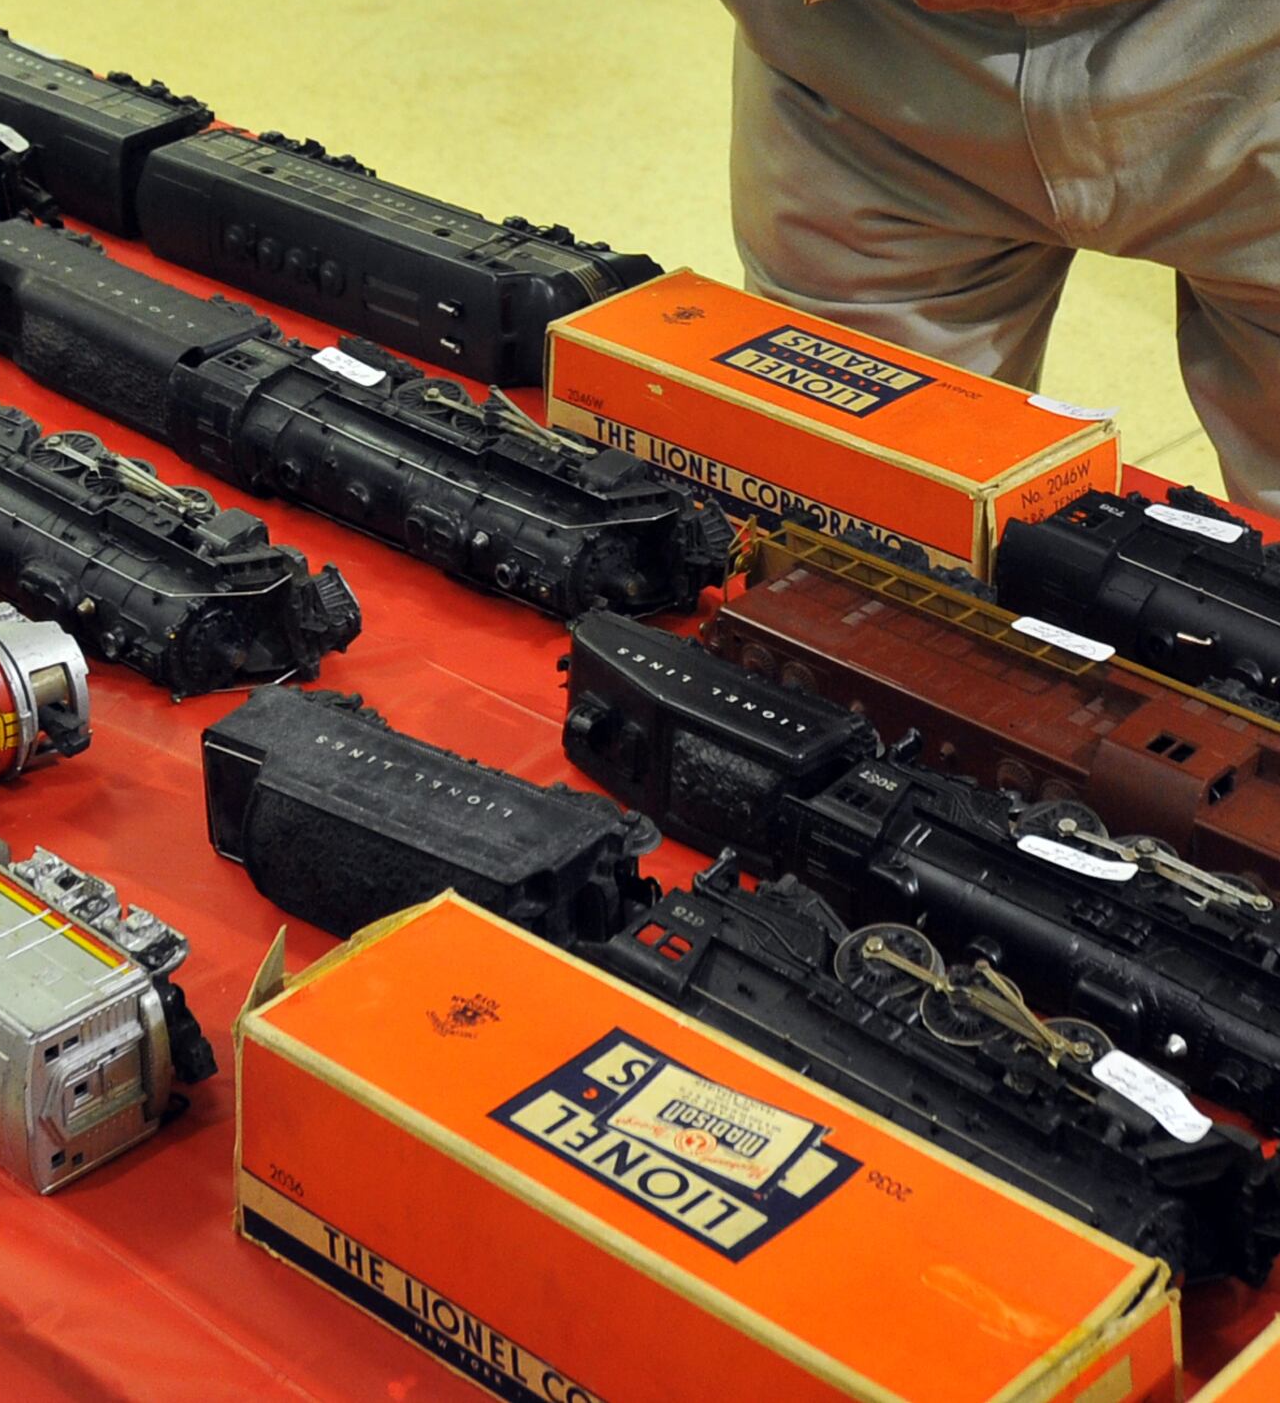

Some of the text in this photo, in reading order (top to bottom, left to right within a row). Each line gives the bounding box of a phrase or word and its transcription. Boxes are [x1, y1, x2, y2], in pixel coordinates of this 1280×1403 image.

[747, 351, 867, 413] LIONEL
[785, 334, 908, 388] TRAINS
[594, 417, 637, 453] THE
[649, 436, 734, 494] LIONEL
[1046, 458, 1093, 494] 2046W
[616, 647, 807, 734] LIONEL LINES
[314, 734, 514, 820] LIONEL LINES
[662, 1101, 765, 1157] MADISON
[268, 1163, 305, 1198] 2036
[543, 1103, 741, 1231] LIONEL
[867, 1169, 914, 1203] 2036
[322, 1224, 386, 1293] THE
[404, 1277, 529, 1386] LIONEL
[413, 1321, 505, 1387] NEW YORK
